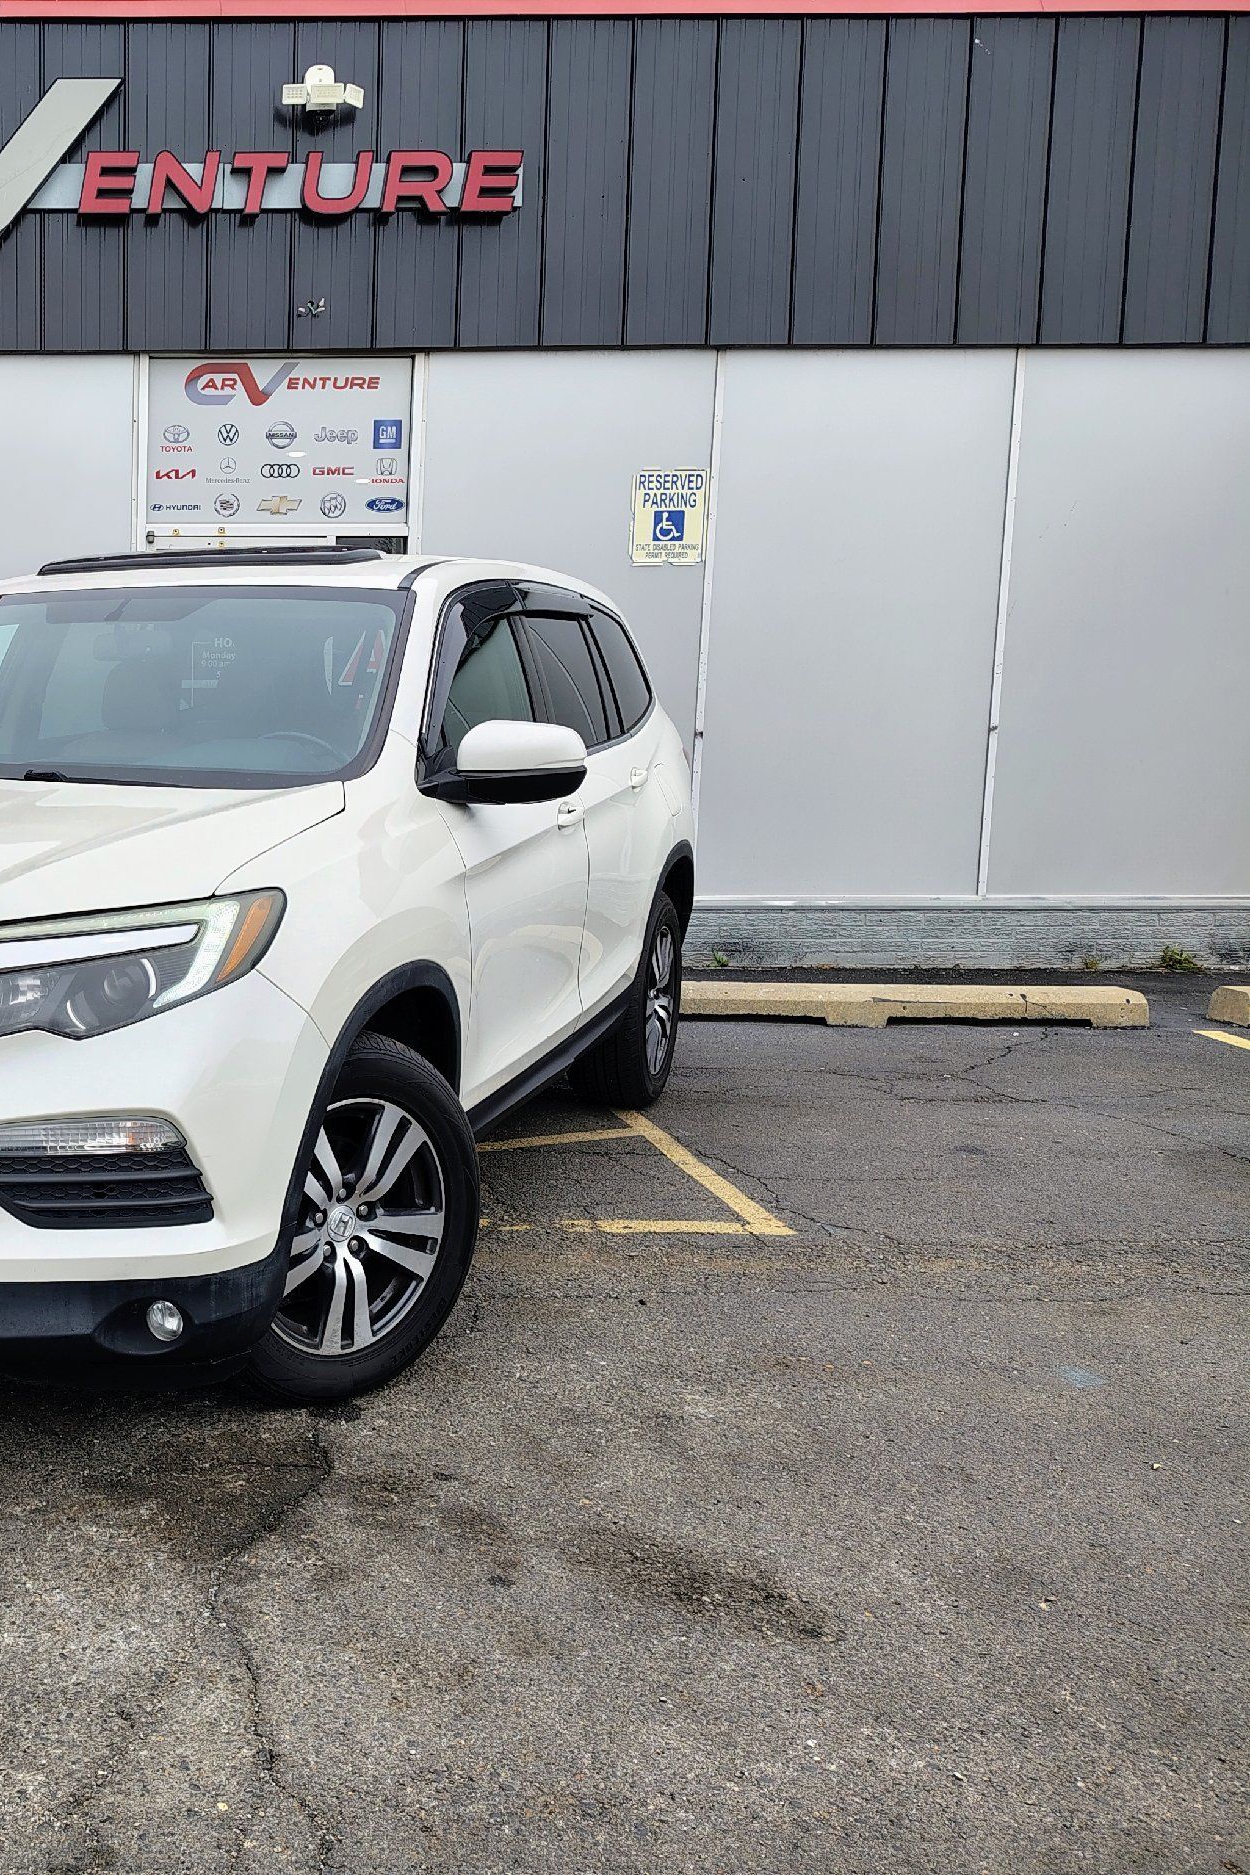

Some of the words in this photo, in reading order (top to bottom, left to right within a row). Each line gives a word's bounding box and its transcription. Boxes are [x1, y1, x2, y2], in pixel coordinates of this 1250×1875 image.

[313, 426, 358, 444] Jeep
[379, 426, 397, 439] GM
[160, 445, 193, 453] TOYOTA
[312, 466, 355, 476] GMC
[638, 473, 704, 491] RESERVED
[373, 499, 397, 510] Ford
[642, 492, 697, 508] PARKING
[635, 543, 651, 551] STATE
[652, 543, 676, 551] DISABLED
[678, 543, 700, 551] PARKING
[645, 551, 663, 559] PERMIT
[665, 551, 689, 559] REQUIRED
